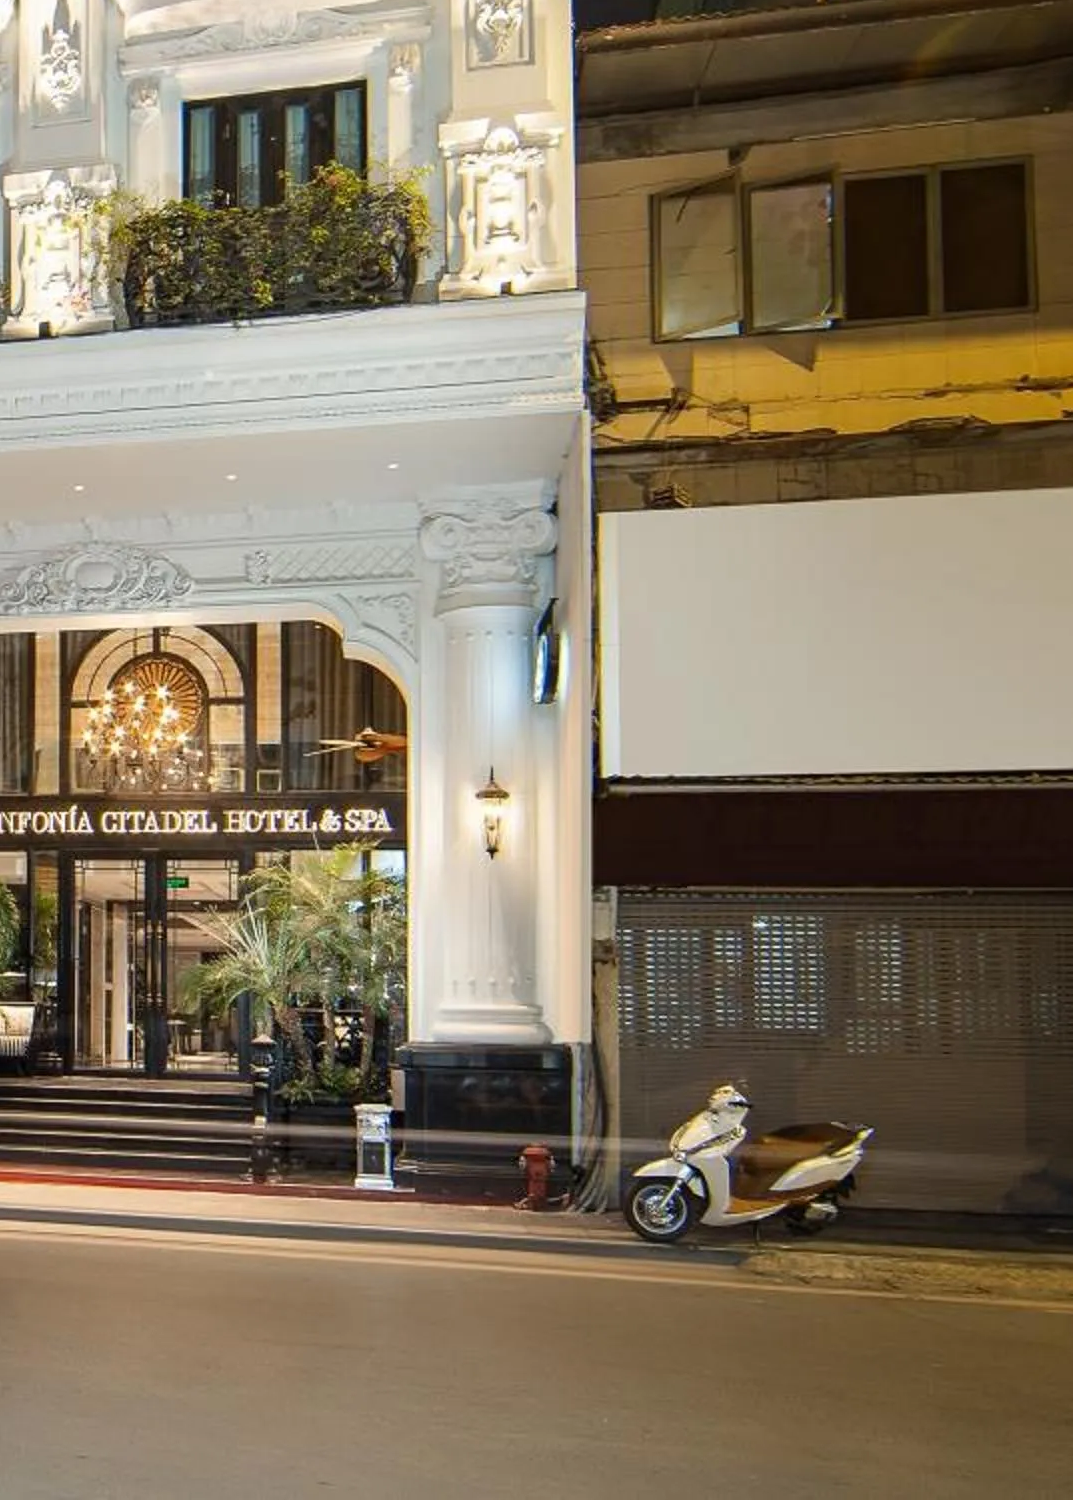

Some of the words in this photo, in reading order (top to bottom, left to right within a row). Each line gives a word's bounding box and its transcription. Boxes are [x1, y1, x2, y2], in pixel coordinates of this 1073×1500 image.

[101, 810, 217, 833] CITADEL
[223, 809, 317, 833] HOTEL
[343, 808, 392, 832] SPA
